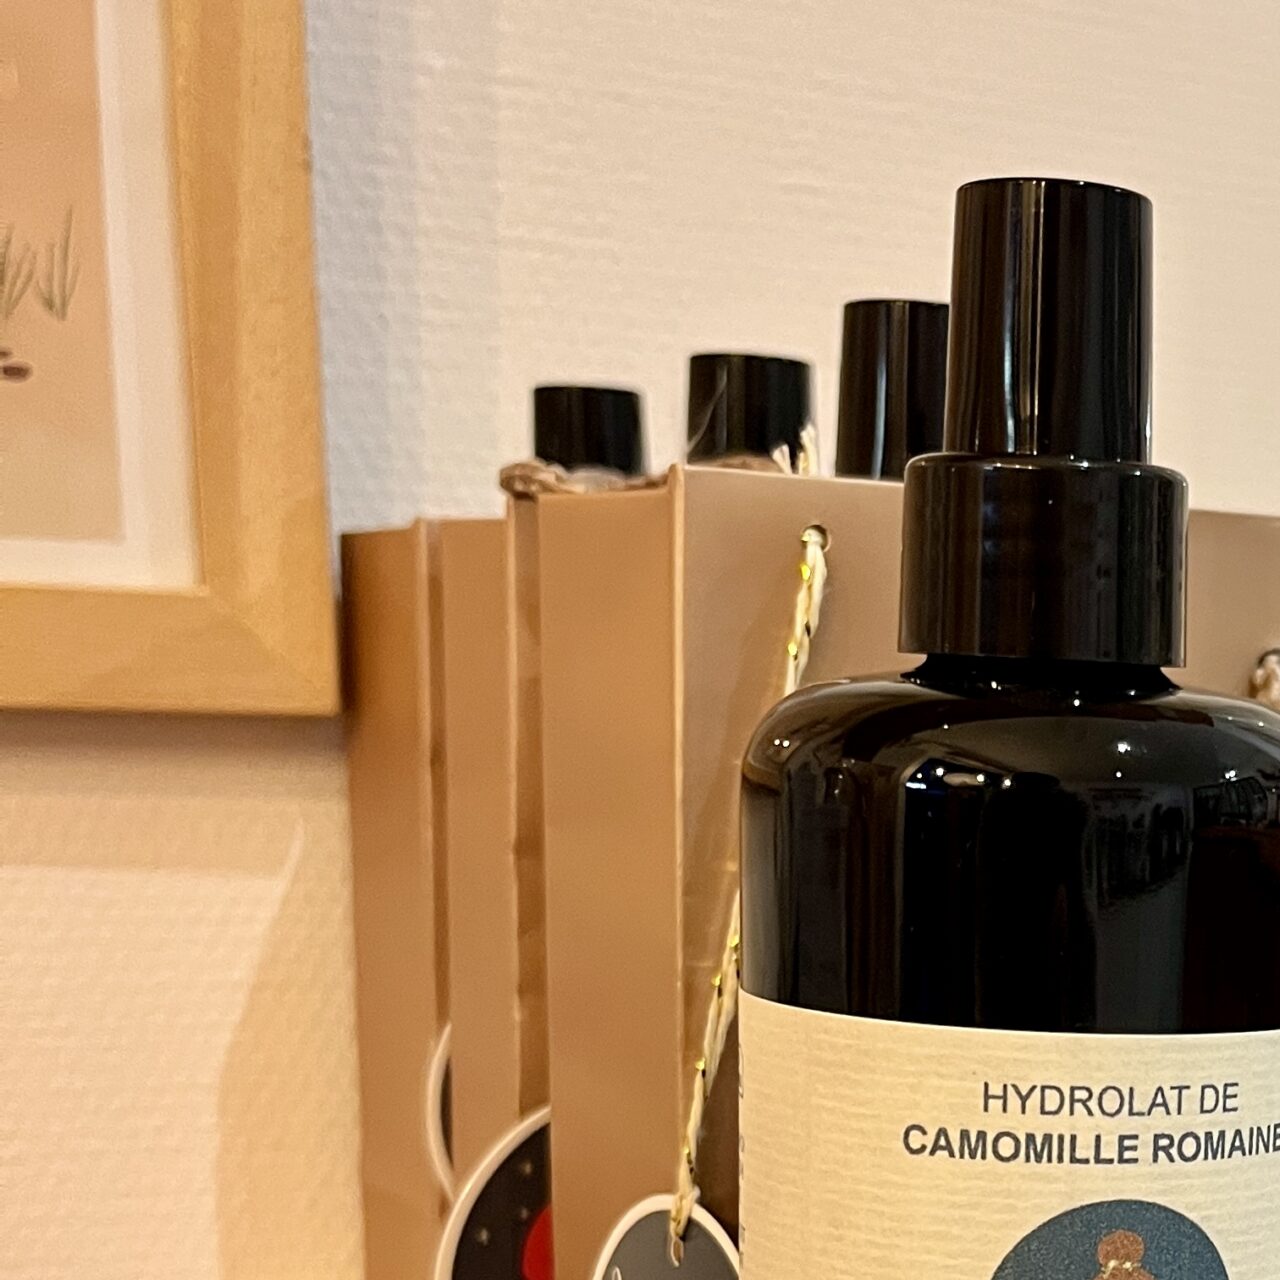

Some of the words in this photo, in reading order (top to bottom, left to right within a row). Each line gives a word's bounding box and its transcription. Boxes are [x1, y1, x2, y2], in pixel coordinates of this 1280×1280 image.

[983, 1081, 1191, 1118] HYDROLAT
[1200, 1082, 1239, 1114] DE
[903, 1124, 1139, 1165] CAMOMILLE
